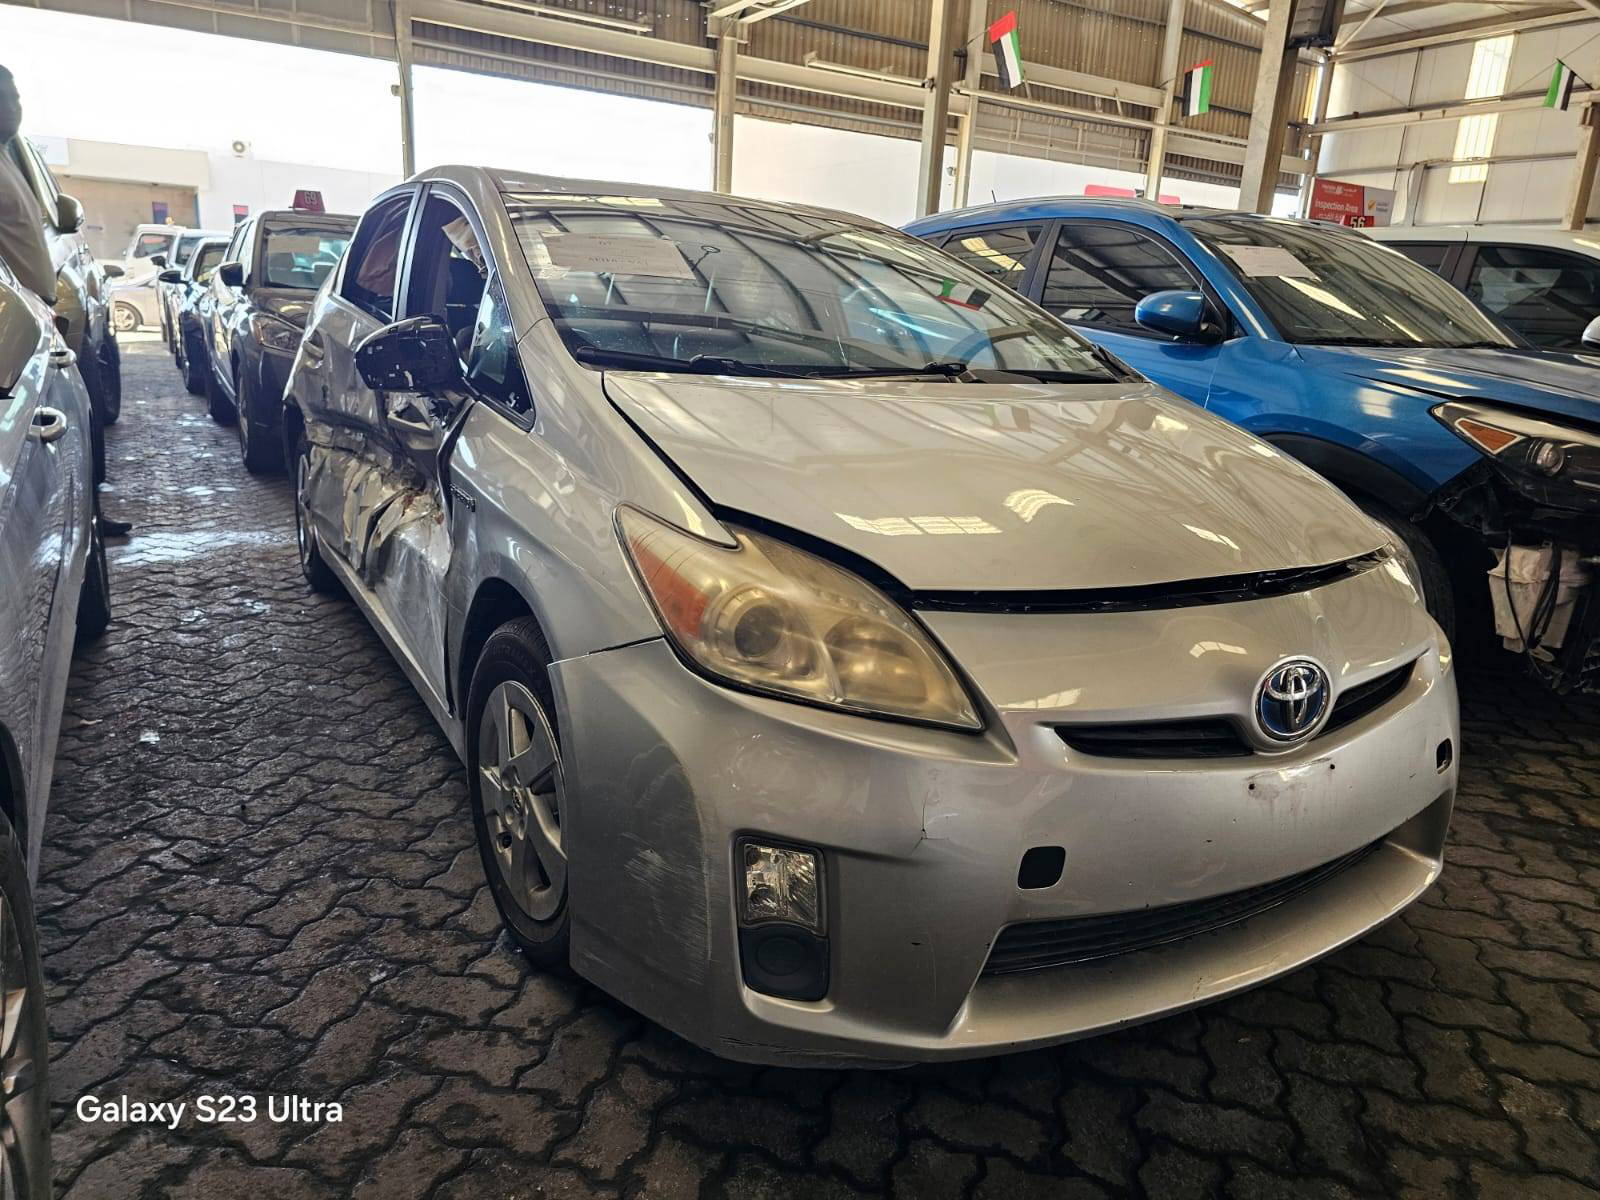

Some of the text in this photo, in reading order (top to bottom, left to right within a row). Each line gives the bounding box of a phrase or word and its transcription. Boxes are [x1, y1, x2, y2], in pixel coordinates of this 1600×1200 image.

[1315, 199, 1358, 213] Inspection Area
[1350, 216, 1366, 228] 56
